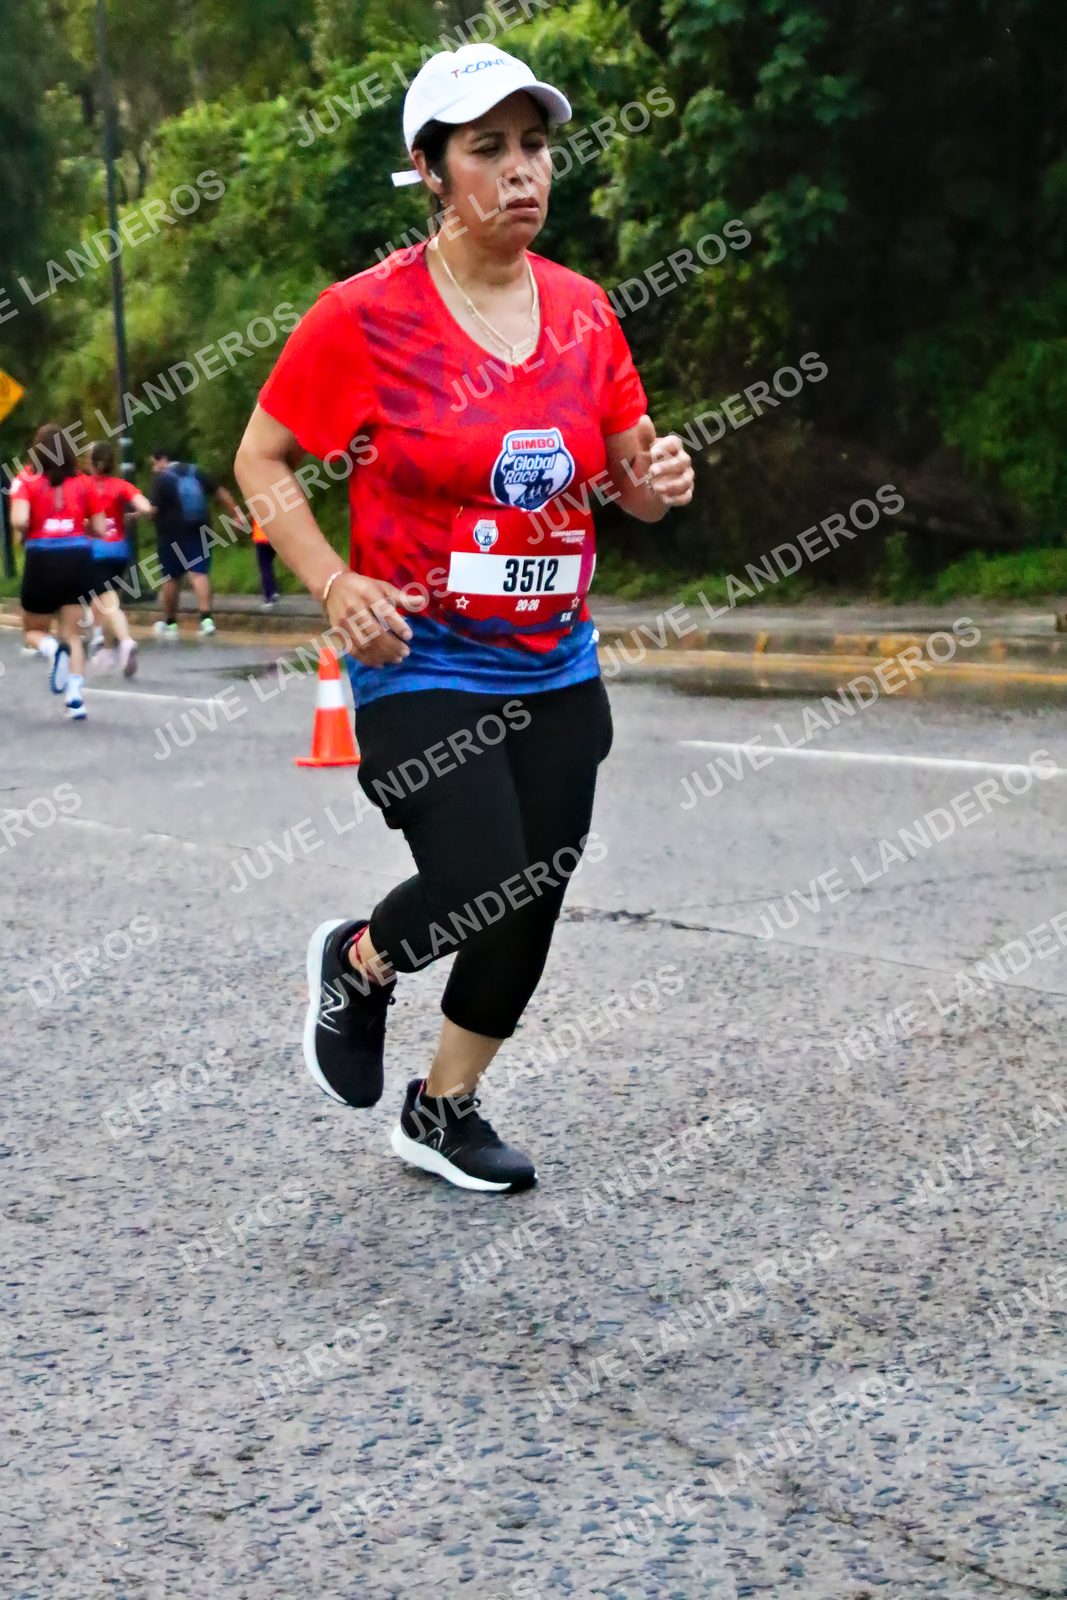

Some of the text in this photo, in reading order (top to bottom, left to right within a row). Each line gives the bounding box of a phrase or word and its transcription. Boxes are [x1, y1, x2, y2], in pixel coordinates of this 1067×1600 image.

[511, 438, 555, 450] BIMBO
[513, 454, 556, 471] Global
[504, 469, 539, 484] Race
[503, 558, 559, 593] 3512
